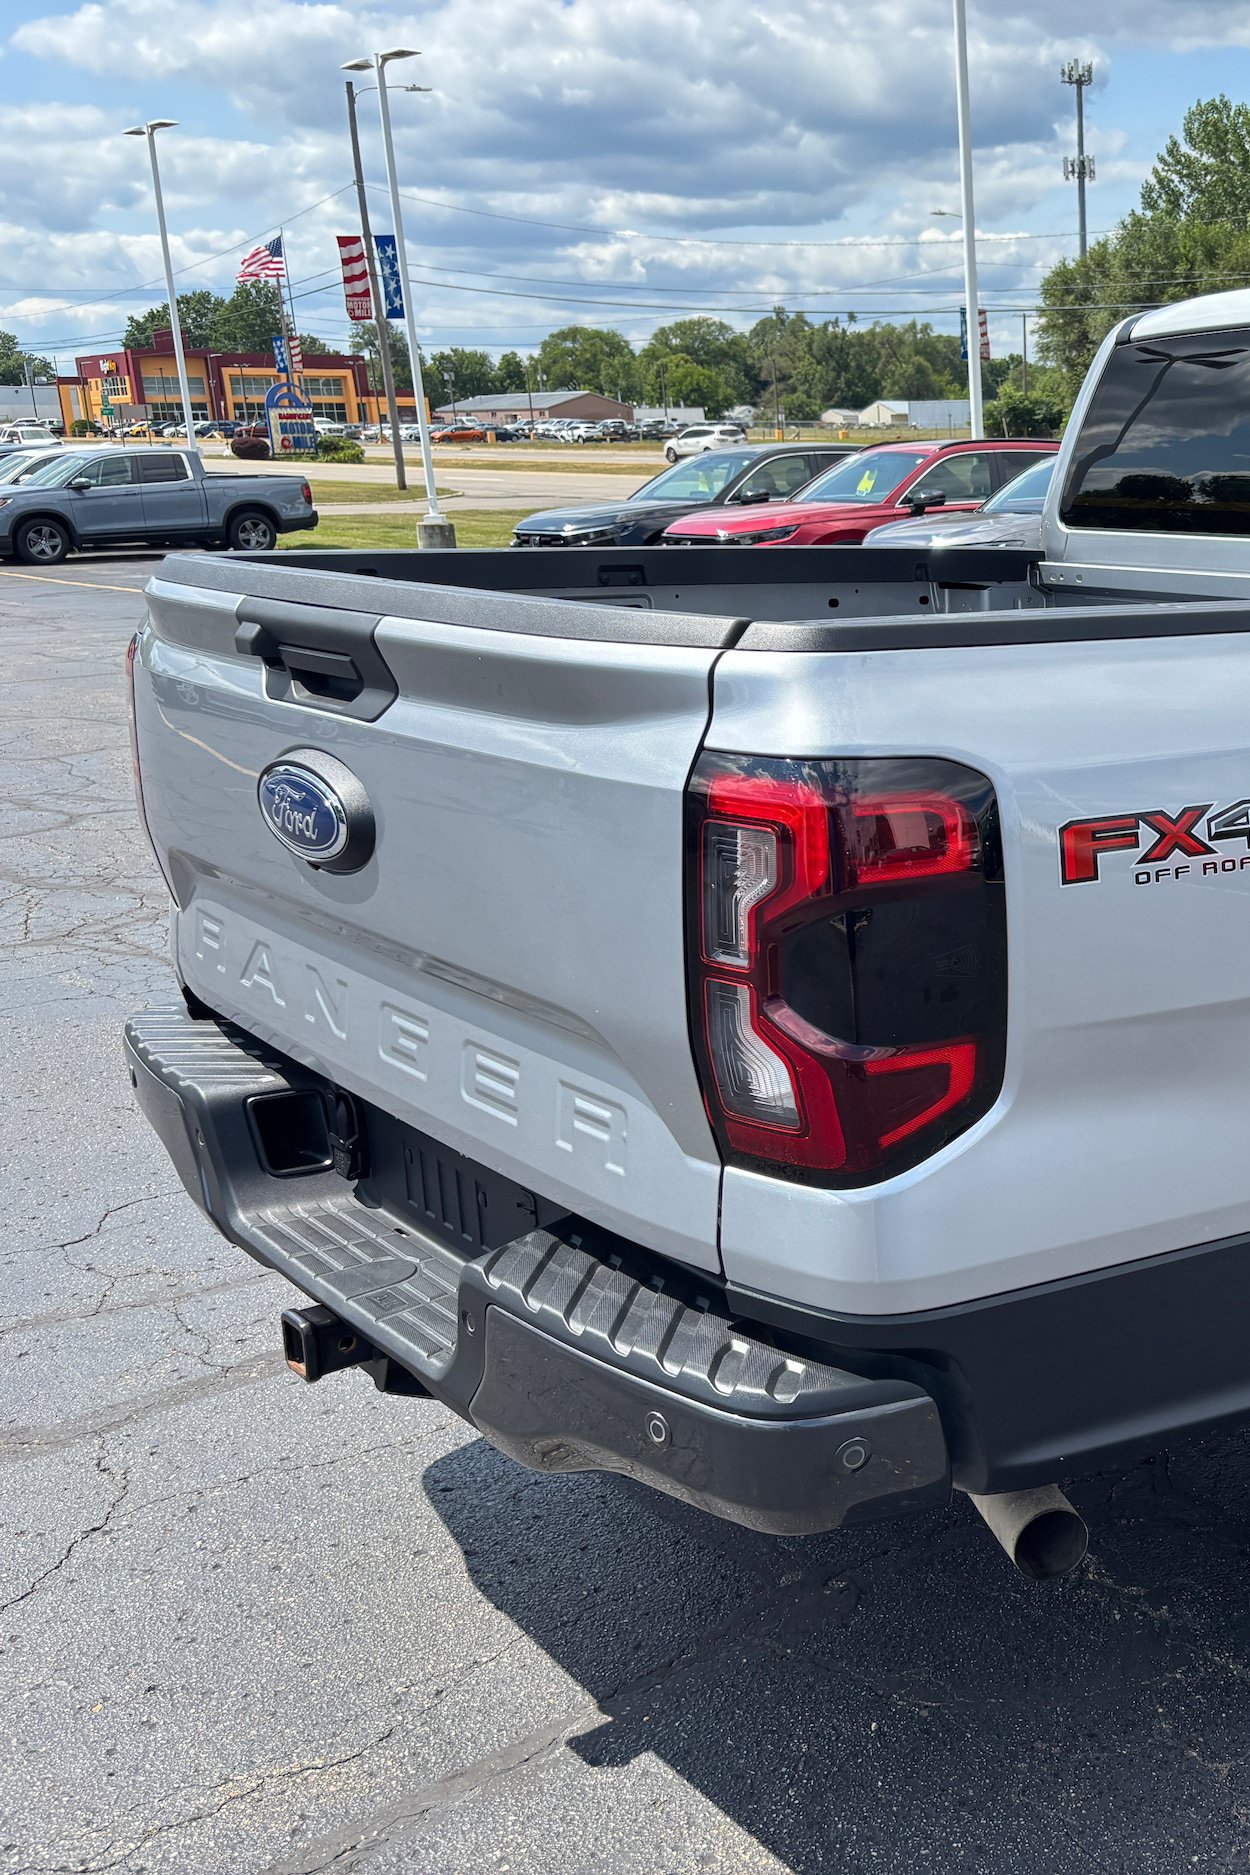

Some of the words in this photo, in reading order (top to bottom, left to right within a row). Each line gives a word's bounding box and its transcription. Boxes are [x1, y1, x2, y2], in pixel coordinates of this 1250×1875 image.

[272, 783, 318, 840] Ford
[1134, 864, 1191, 886] OFF
[196, 907, 628, 1178] RANGER
